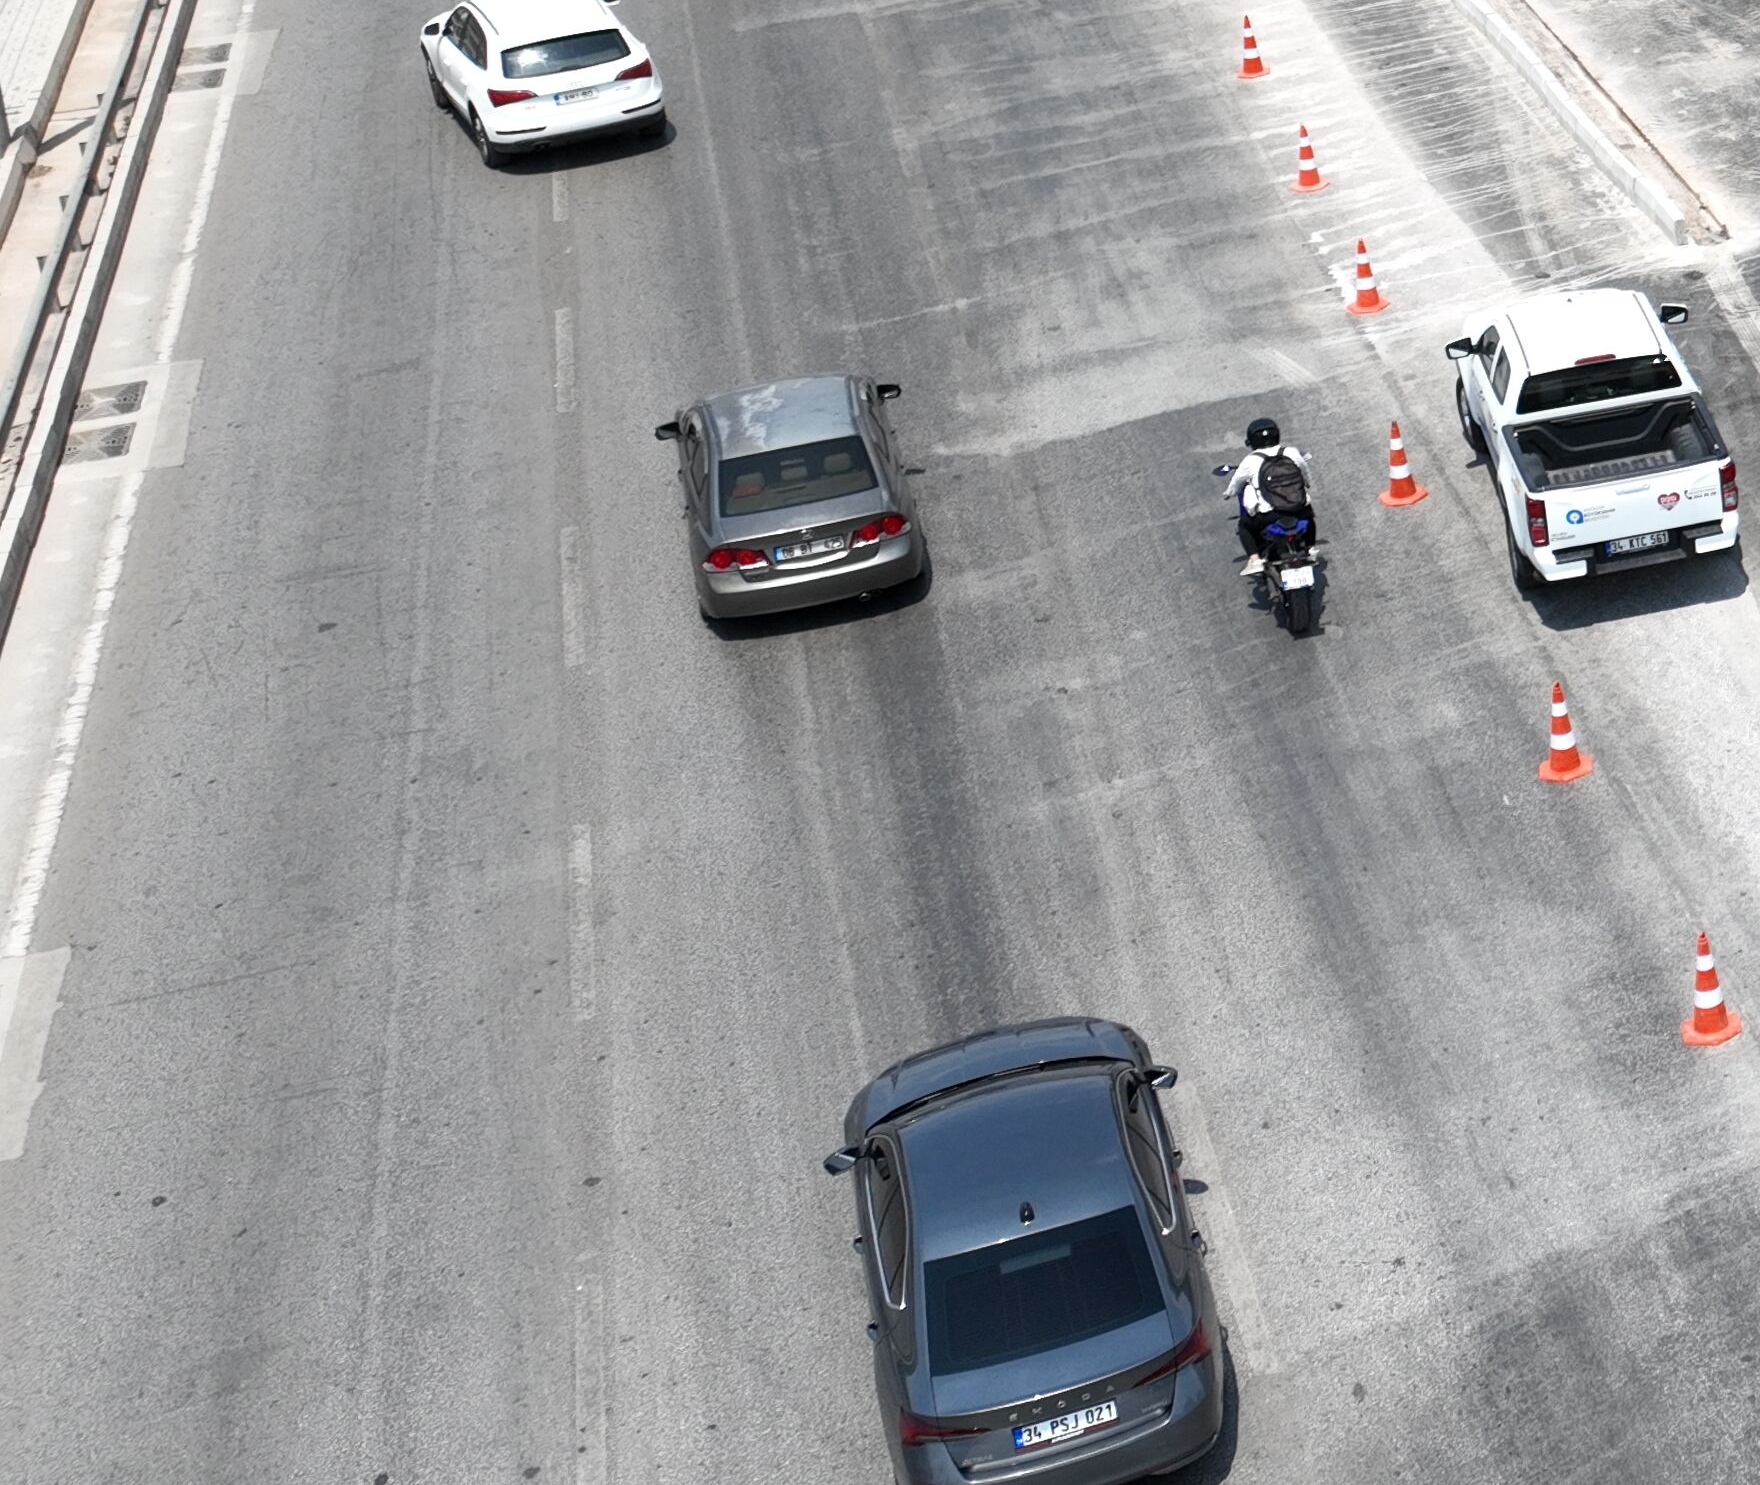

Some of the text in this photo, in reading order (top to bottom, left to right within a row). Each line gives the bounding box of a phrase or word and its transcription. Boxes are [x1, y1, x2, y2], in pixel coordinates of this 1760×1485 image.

[1611, 532, 1668, 553] 34 KTC 561
[1023, 1426, 1042, 1443] 34
[1050, 1414, 1079, 1435] PSJ
[1086, 1403, 1113, 1424] 021
